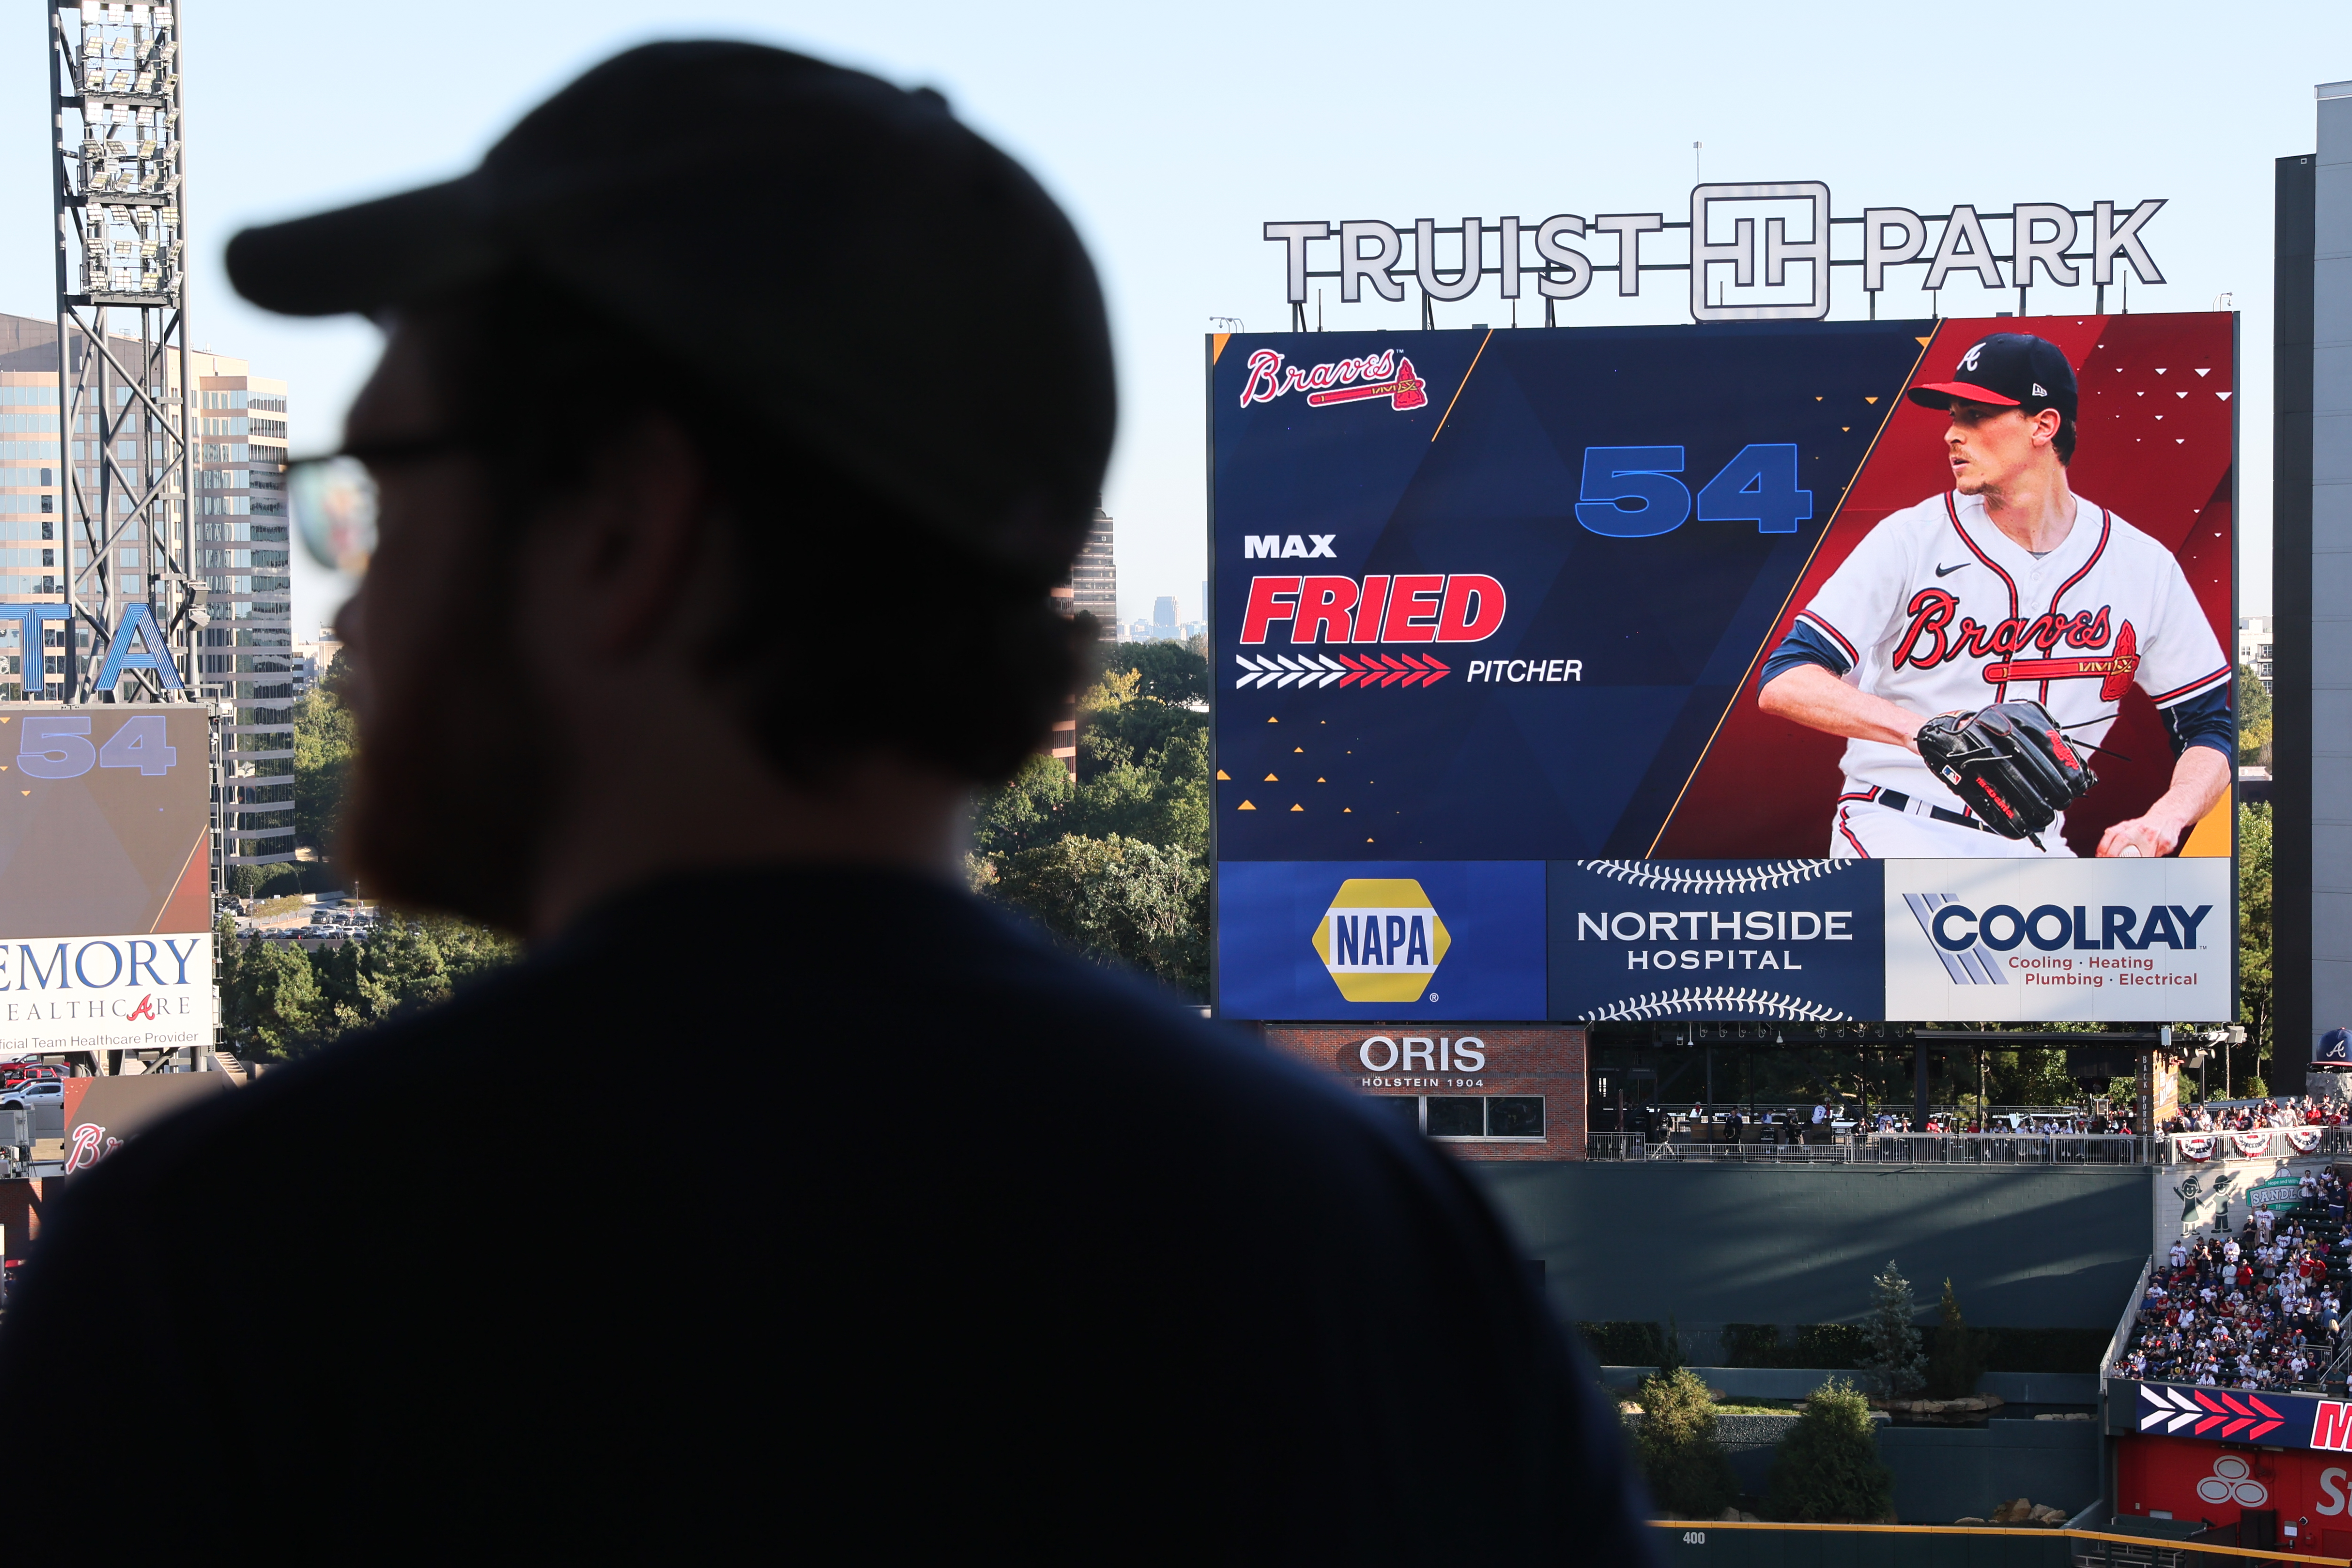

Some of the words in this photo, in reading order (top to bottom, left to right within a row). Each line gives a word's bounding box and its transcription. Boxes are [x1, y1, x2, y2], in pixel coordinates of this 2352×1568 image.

[1263, 213, 1663, 304] TRUIST
[1863, 199, 2169, 292] PARK
[1239, 348, 1395, 408] Braves
[1575, 444, 1813, 537] 54
[1244, 534, 1337, 559] MAX
[1239, 574, 1506, 645] FRIED
[1893, 587, 2111, 672] Braves
[1467, 659, 1582, 683] PITCHER
[16, 715, 176, 779] 54
[1337, 915, 1429, 965] NAPA
[1578, 911, 1853, 941] NORTHSIDE
[1932, 904, 2214, 951] COOLRAY
[1628, 949, 1802, 970] HOSPITAL
[2008, 956, 2072, 971] Cooling
[2089, 956, 2153, 971] Heating
[2025, 972, 2103, 987] Plumbing
[2119, 972, 2198, 985] Electrical
[31, 1037, 66, 1048] Team
[71, 1034, 141, 1047] Healthcare
[145, 1032, 199, 1043] Provider
[1360, 1036, 1485, 1072] ORIS
[1362, 1076, 1439, 1087] HÖLSTEIN
[1683, 1532, 1705, 1544] 400
